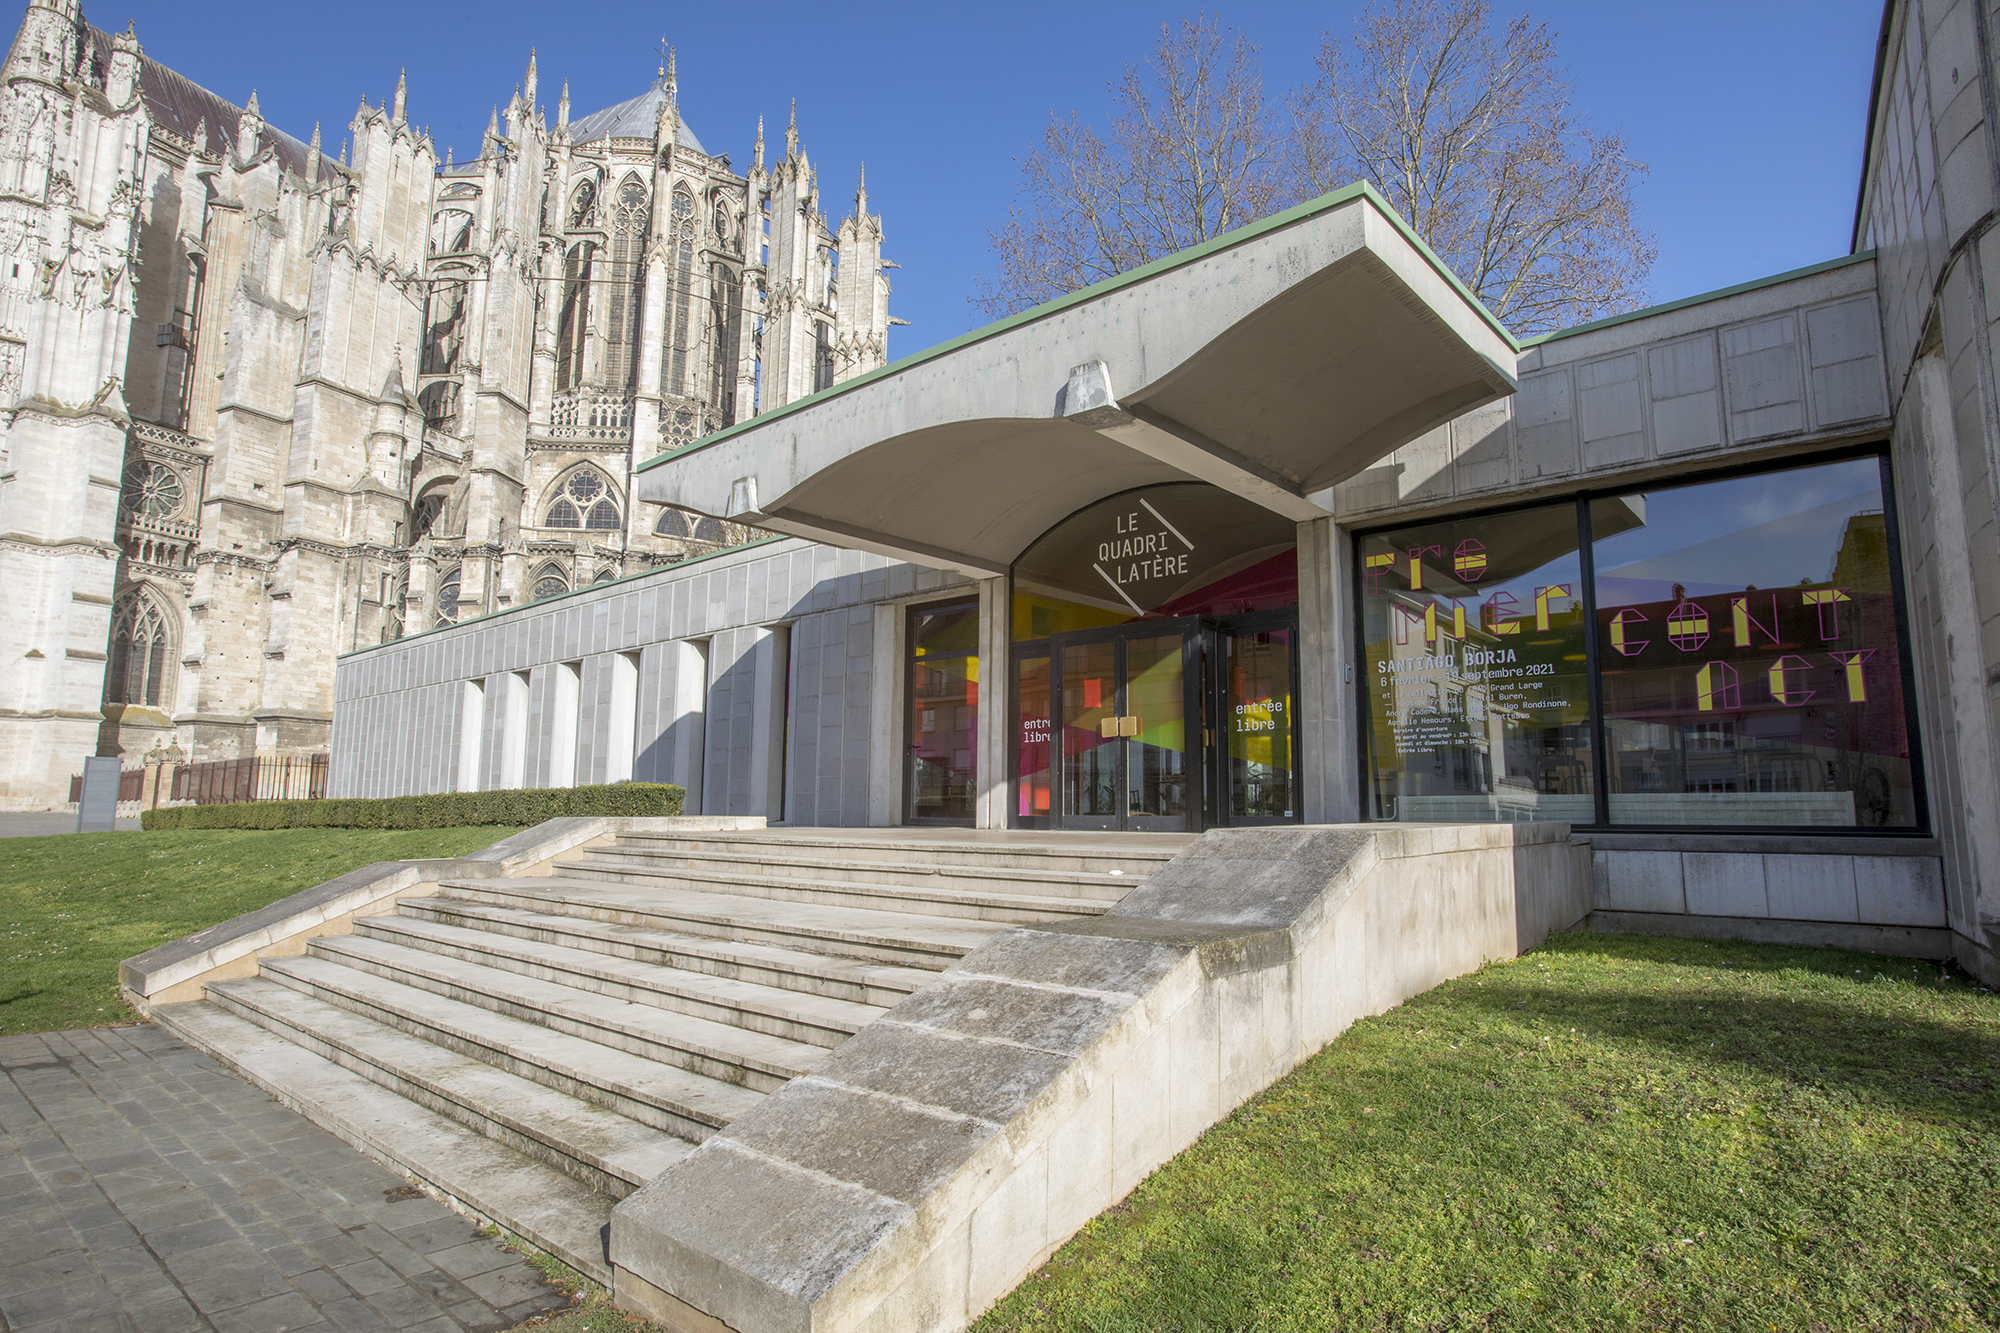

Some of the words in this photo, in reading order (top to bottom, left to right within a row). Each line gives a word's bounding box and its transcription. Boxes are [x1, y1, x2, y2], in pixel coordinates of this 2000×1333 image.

[1117, 512, 1138, 534] LE
[1099, 531, 1168, 562] QUADRI
[1117, 553, 1188, 584] LATÈRE
[1378, 654, 1454, 674] SANTIAGO
[1465, 648, 1517, 667] BORJA
[1380, 676, 1388, 687] 6
[1446, 671, 1459, 682] 19
[1461, 667, 1524, 682] septembre
[1526, 663, 1555, 676] 2021
[1490, 682, 1514, 692] Grand
[1518, 682, 1544, 692] Large
[1236, 699, 1283, 716] entrée
[1504, 702, 1518, 710] Ugo
[1236, 718, 1276, 732] libre
